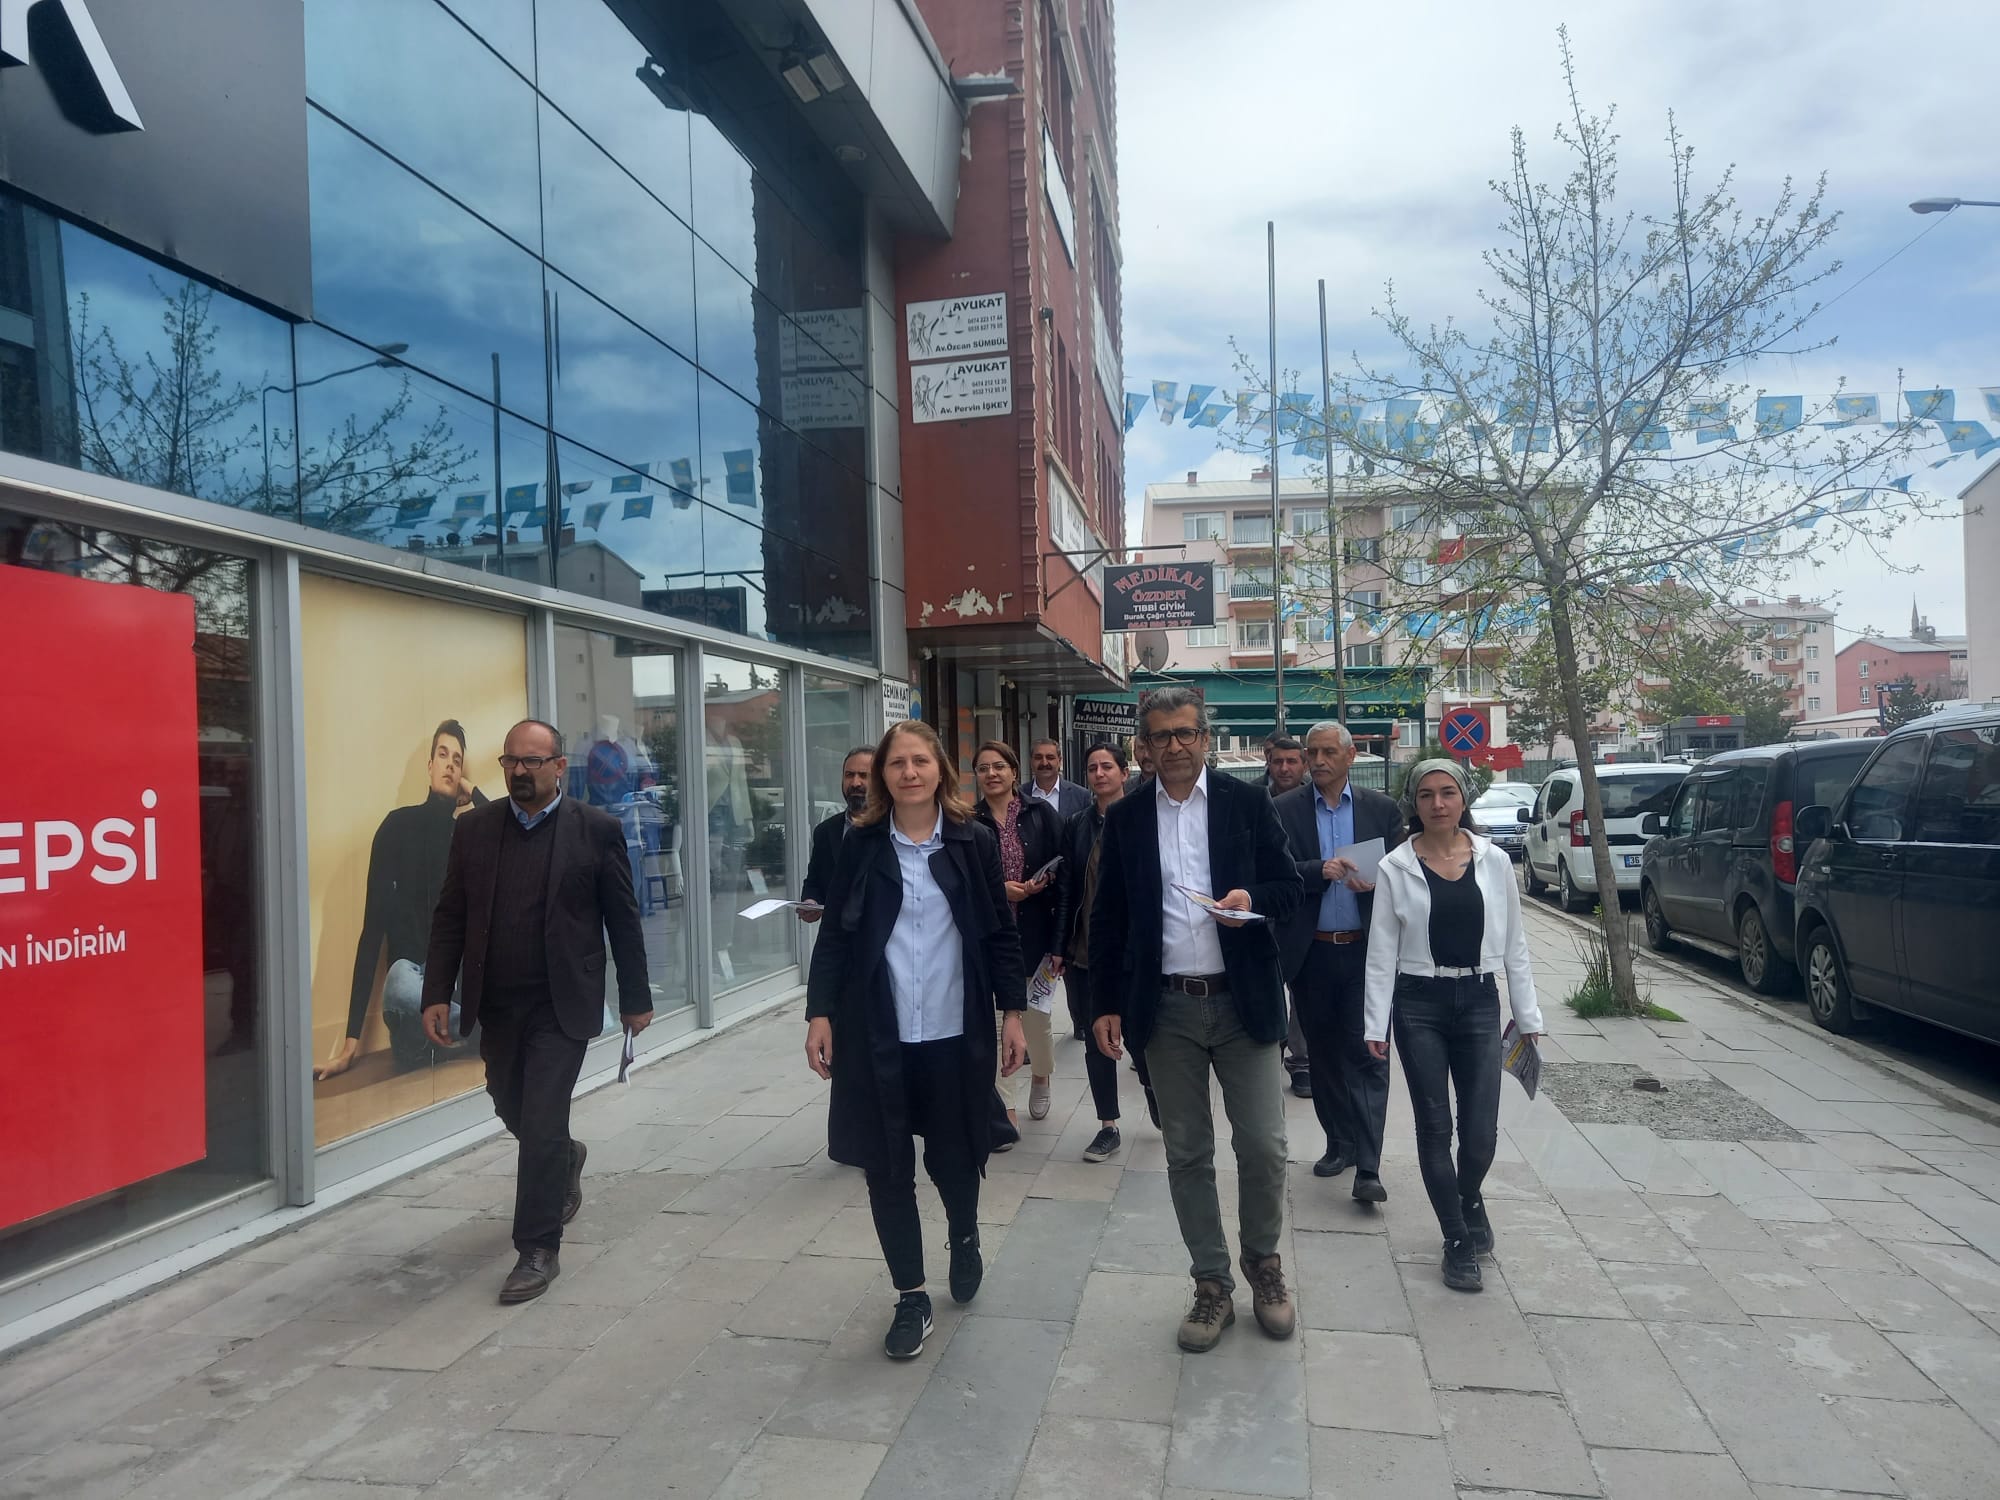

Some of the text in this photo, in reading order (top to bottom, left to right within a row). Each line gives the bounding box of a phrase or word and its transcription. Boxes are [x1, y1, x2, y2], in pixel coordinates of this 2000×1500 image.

[953, 297, 1002, 311] AVUKAT
[973, 337, 1006, 348] SÜMBÜL
[957, 361, 1007, 375] AVUKAT
[955, 404, 980, 413] Pervin
[1113, 565, 1205, 594] MEDİKAL
[1132, 589, 1187, 602] ÖZDEN
[1133, 601, 1185, 612] TIBBİ GİYİM
[1146, 612, 1165, 621] Çağrı
[1166, 610, 1195, 618] ÖZTÜRK
[883, 682, 909, 702] ZEMİN KAT
[1083, 702, 1130, 715] AVUKAT
[0, 789, 157, 893] EPSİ
[26, 924, 126, 965] İNDİRİM
